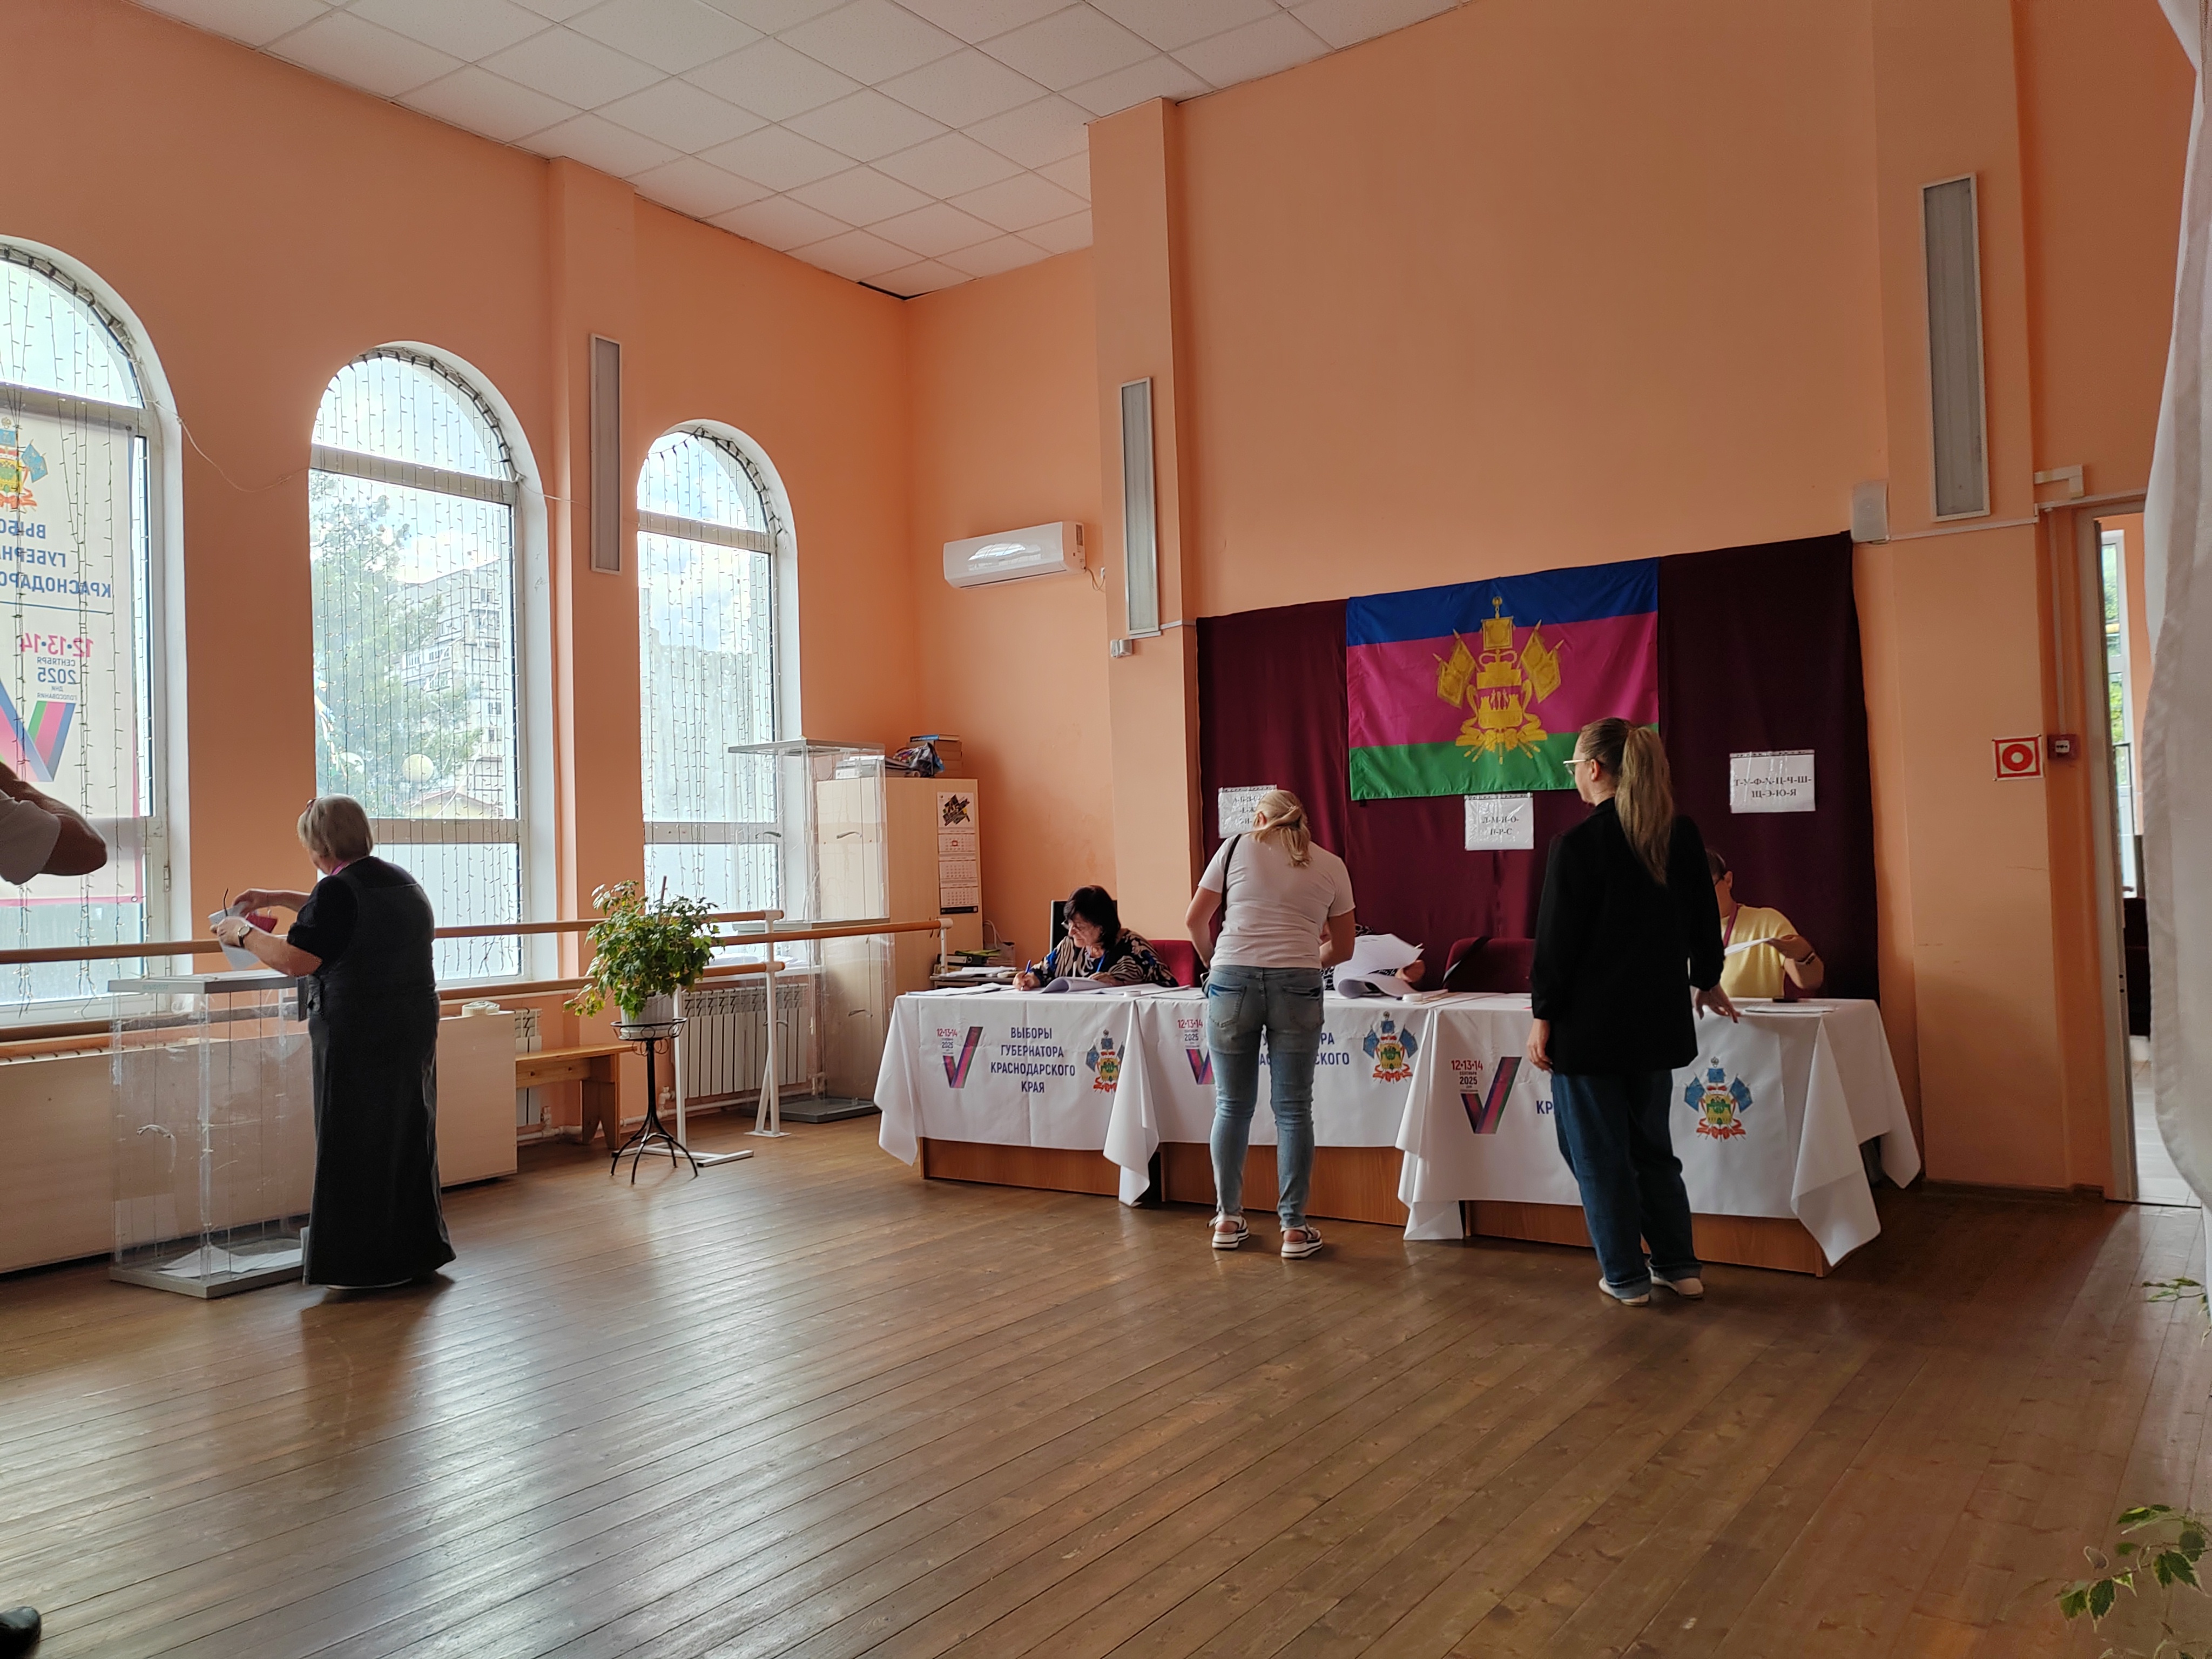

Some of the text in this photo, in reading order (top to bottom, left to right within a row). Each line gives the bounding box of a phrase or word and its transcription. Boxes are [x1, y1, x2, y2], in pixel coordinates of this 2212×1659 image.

[1010, 1027, 1052, 1039] ВЫБОРЫ
[1001, 1044, 1064, 1057] ГУБЕРНАТОРА
[990, 1062, 1075, 1076] КРАСНОДАРСКОГО
[1460, 1076, 1478, 1084] 2025
[1021, 1081, 1044, 1093] КРАЯ
[1536, 1100, 1553, 1114] КР
